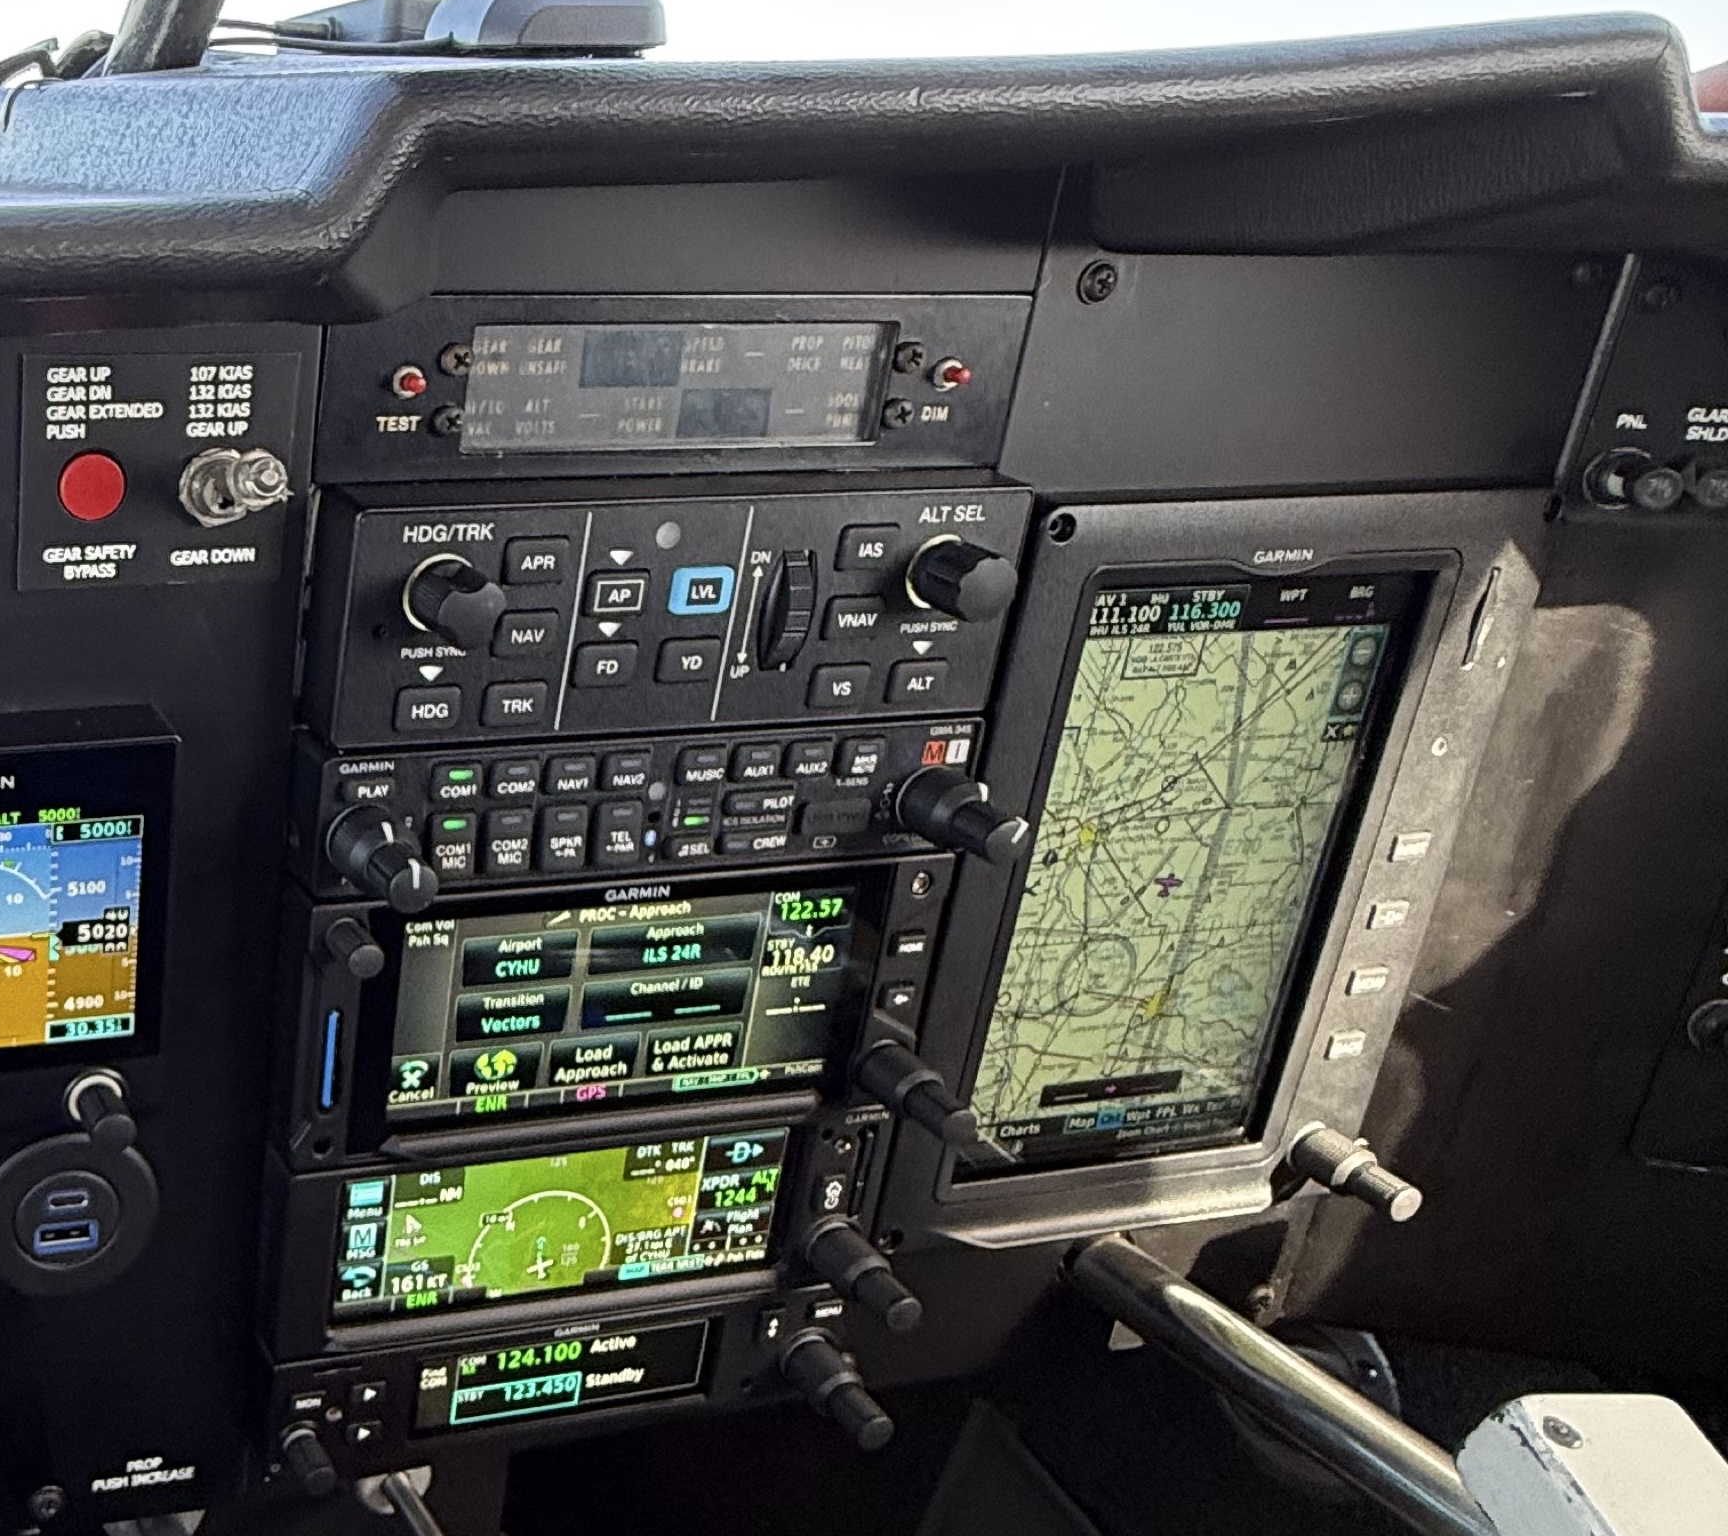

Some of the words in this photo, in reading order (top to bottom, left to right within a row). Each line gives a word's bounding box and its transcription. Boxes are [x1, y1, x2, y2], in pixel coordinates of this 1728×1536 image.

[47, 367, 86, 383] GEAR
[90, 366, 110, 383] UP
[190, 366, 215, 381] 107
[219, 365, 253, 381] KIAS
[47, 386, 84, 401] GEAR
[90, 385, 111, 401] DN
[189, 385, 215, 400] 132
[219, 384, 251, 399] KIAS
[46, 404, 86, 422] GEAR
[89, 401, 163, 420] EXTENDED
[188, 403, 214, 419] 132
[216, 401, 251, 418] KIAS
[921, 405, 948, 422] DIM
[187, 422, 224, 437] GEAR
[227, 421, 247, 436] UP
[376, 416, 421, 432] TEST
[1617, 413, 1648, 429] PNL
[46, 423, 86, 440] PUSH
[1686, 425, 1728, 442] SHLD
[919, 505, 952, 524] ALT
[953, 505, 985, 524] SEL
[402, 524, 494, 543] HDG/TRK
[43, 547, 81, 563] GEAR
[84, 545, 135, 561] SAFETY
[170, 549, 214, 565] GEAR
[215, 548, 255, 564] DOWN
[751, 550, 770, 563] DN
[858, 542, 883, 560] IAS
[1253, 548, 1314, 564] GARMIN
[521, 554, 554, 571] APR
[64, 563, 115, 580] BYPASS
[608, 587, 631, 605] AP
[690, 582, 717, 602] LVL
[1169, 601, 1240, 621] 116.300
[838, 612, 877, 630] VNAV
[512, 626, 545, 645] NAV
[597, 659, 618, 676] FD
[832, 681, 851, 698] VS
[907, 676, 933, 694] ALT
[411, 702, 449, 722] HDG
[502, 697, 533, 715] TRK
[340, 760, 395, 775] GARMIN
[686, 767, 724, 782] MUSIC
[497, 779, 535, 795] COM2
[557, 775, 588, 791] NAV1
[613, 772, 645, 787] NAV2
[357, 784, 388, 799] PLAY
[440, 782, 477, 799] COM1
[77, 924, 128, 942] 5020
[497, 936, 543, 953] Airport
[495, 957, 540, 977] CYHU
[64, 994, 104, 1011] 4900
[481, 1012, 540, 1033] Vectors
[575, 1044, 614, 1064] Load
[388, 1084, 434, 1103] Cancel
[465, 1076, 520, 1096] Preview
[497, 1341, 581, 1371] 124.100
[590, 1333, 637, 1353] Active
[504, 1377, 577, 1401] 123.450
[584, 1366, 645, 1388] Standby
